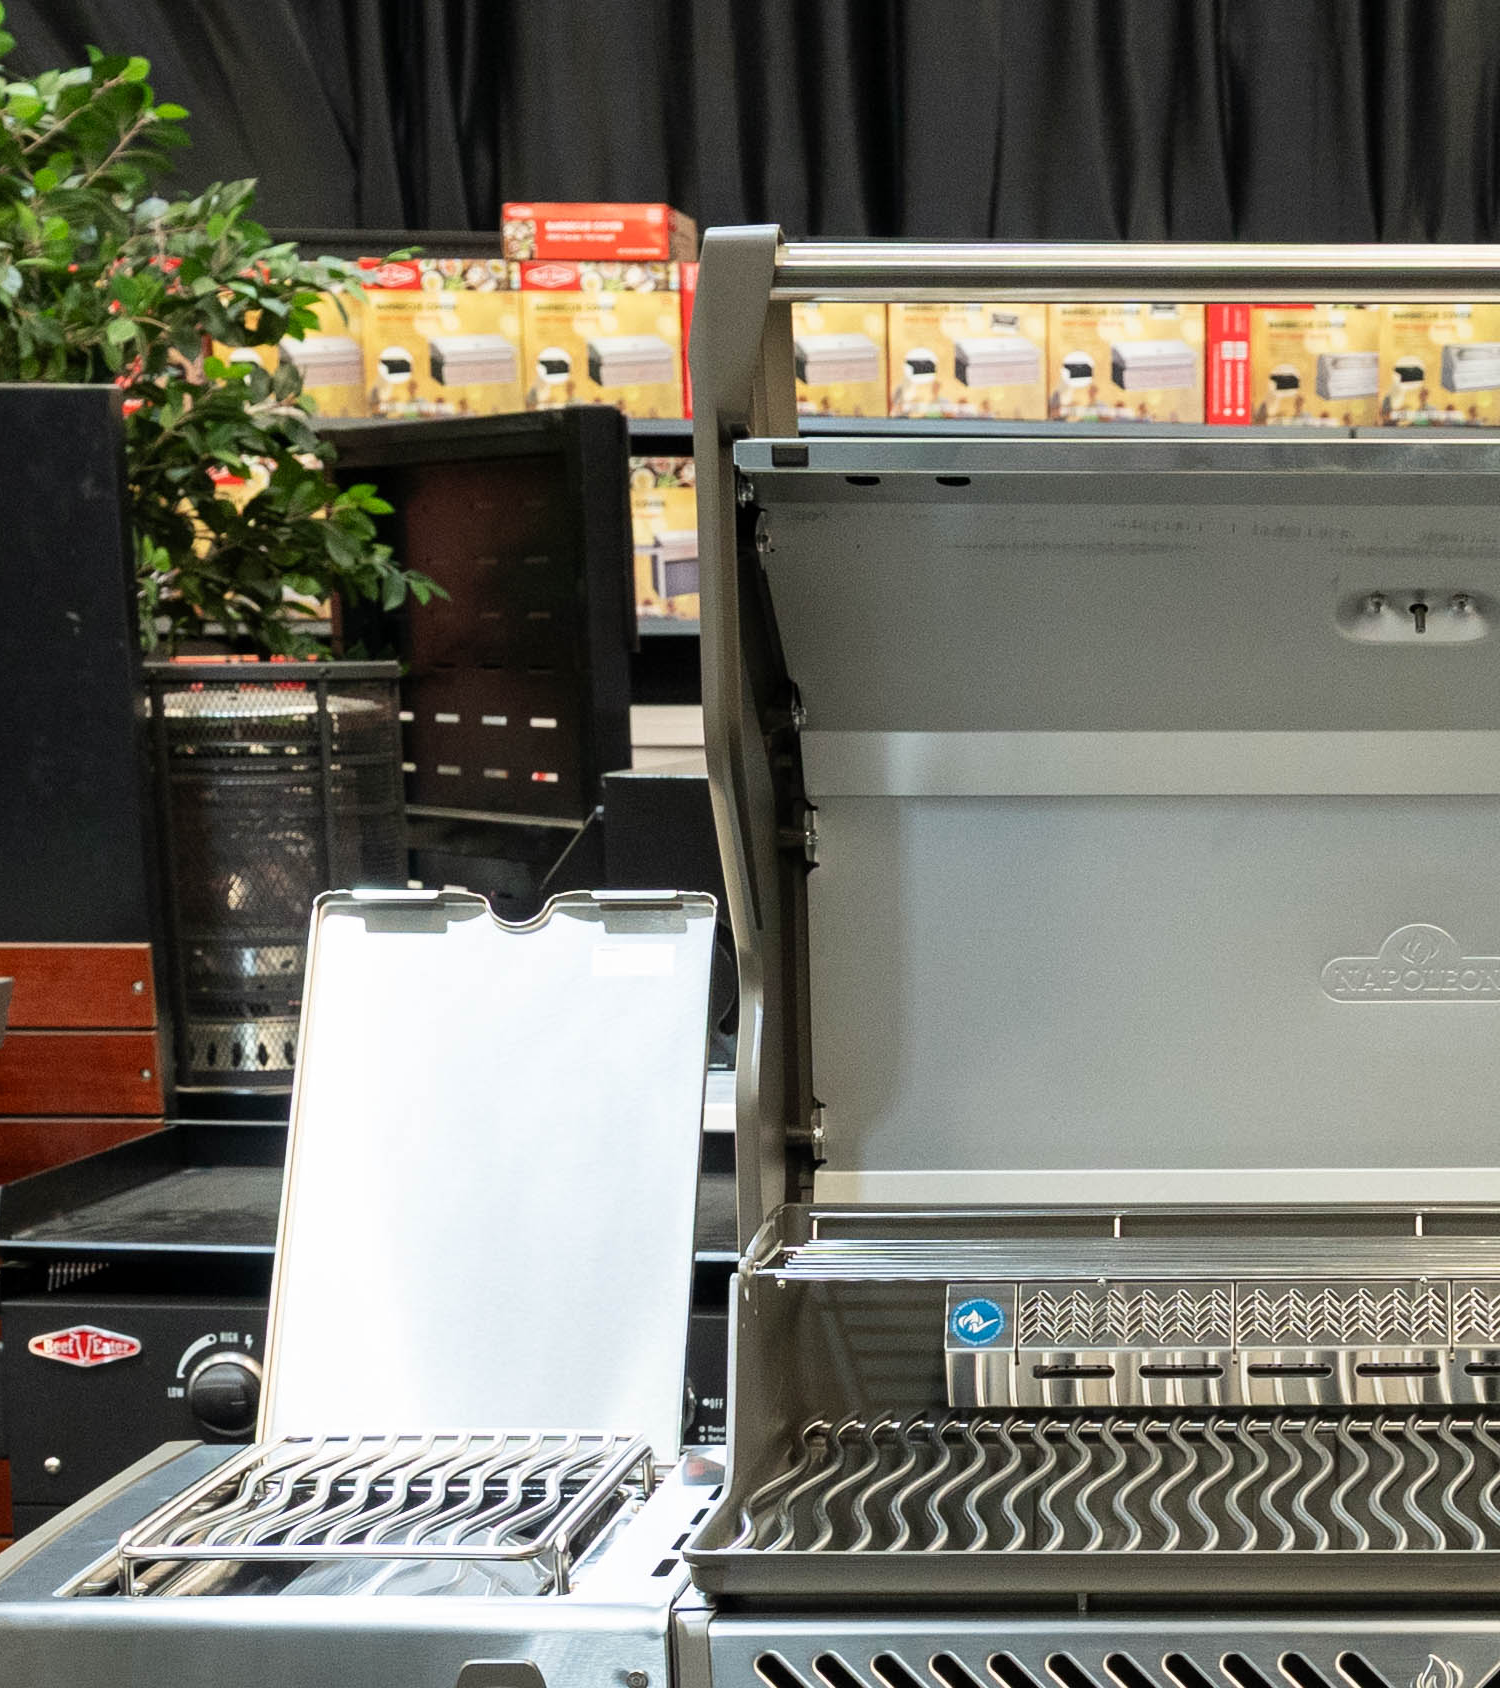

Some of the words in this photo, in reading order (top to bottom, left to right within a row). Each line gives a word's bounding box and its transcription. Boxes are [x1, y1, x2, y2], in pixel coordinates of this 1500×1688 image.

[219, 1332, 239, 1343] HIGH
[42, 1337, 75, 1355] Beef
[92, 1336, 130, 1355] Eater
[167, 1387, 185, 1398] LOW
